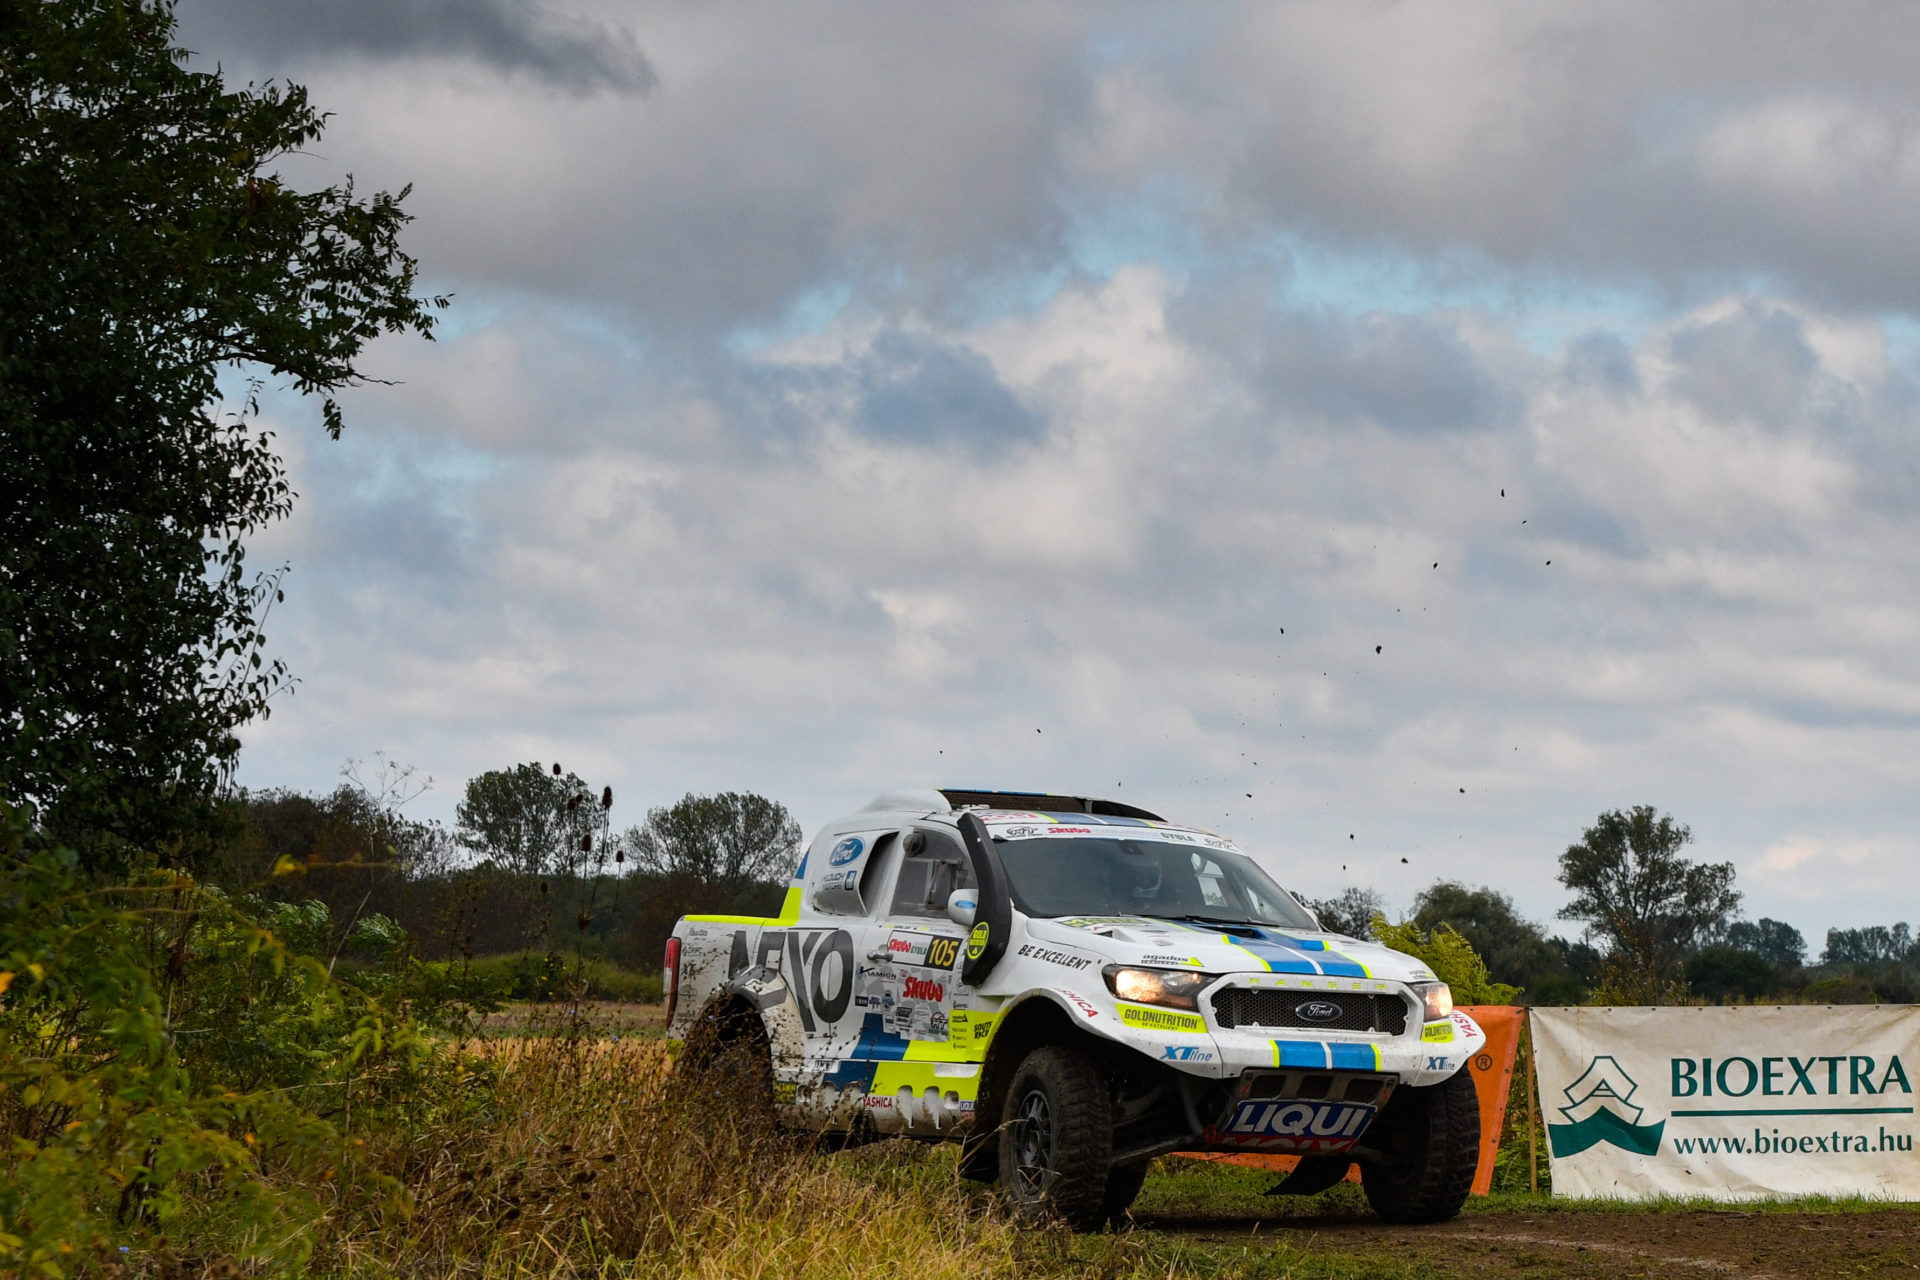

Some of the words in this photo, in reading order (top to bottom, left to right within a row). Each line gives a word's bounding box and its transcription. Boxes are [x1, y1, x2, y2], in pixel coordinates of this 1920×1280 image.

[928, 938, 959, 967] 105
[1018, 944, 1033, 957] BE
[1033, 947, 1093, 971] EXCELLENT
[1248, 978, 1388, 991] RANGER
[1124, 1008, 1198, 1029] GOLDNUTRITION
[1307, 1003, 1335, 1017] Ford
[1158, 1045, 1213, 1061] XTline
[1426, 1056, 1456, 1071] XTline
[1671, 1055, 1913, 1097] BIOEXTRA
[863, 1096, 893, 1108] YASHICA
[1231, 1104, 1367, 1136] LIQUI
[1673, 1126, 1913, 1154] www.bioextra.hu
